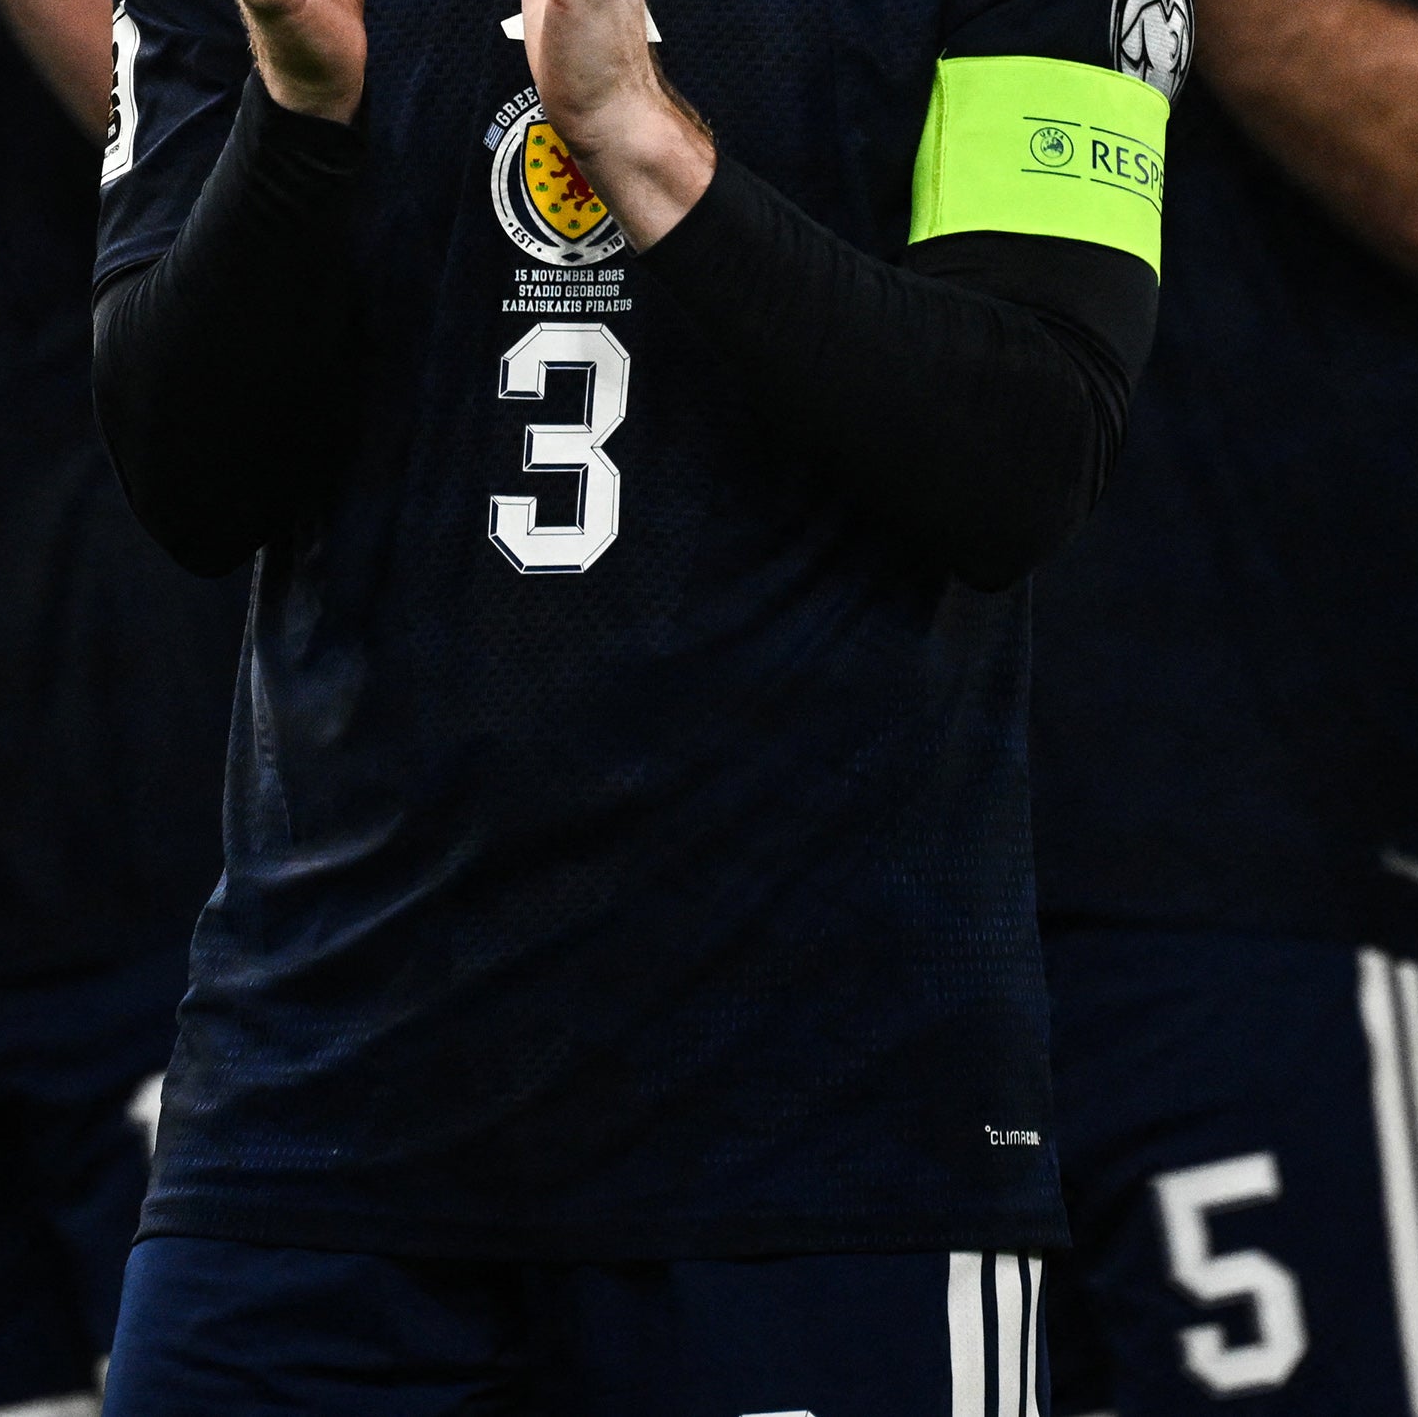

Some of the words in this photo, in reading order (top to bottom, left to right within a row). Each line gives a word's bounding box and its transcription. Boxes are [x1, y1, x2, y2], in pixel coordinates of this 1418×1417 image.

[495, 85, 542, 128] GREE
[1091, 138, 1165, 203] RESPE
[511, 227, 536, 249] EST
[607, 231, 624, 250] 18
[514, 269, 528, 282] 15
[531, 269, 594, 282] NOVEMBER
[598, 269, 625, 282] 2025
[518, 284, 562, 297] STADIO
[565, 284, 620, 297] GEORGIOS
[502, 299, 582, 313] KARAISKAKIS
[585, 298, 633, 312] PIRAEUS
[488, 322, 631, 574] 3
[1154, 1151, 1309, 1397] 5
